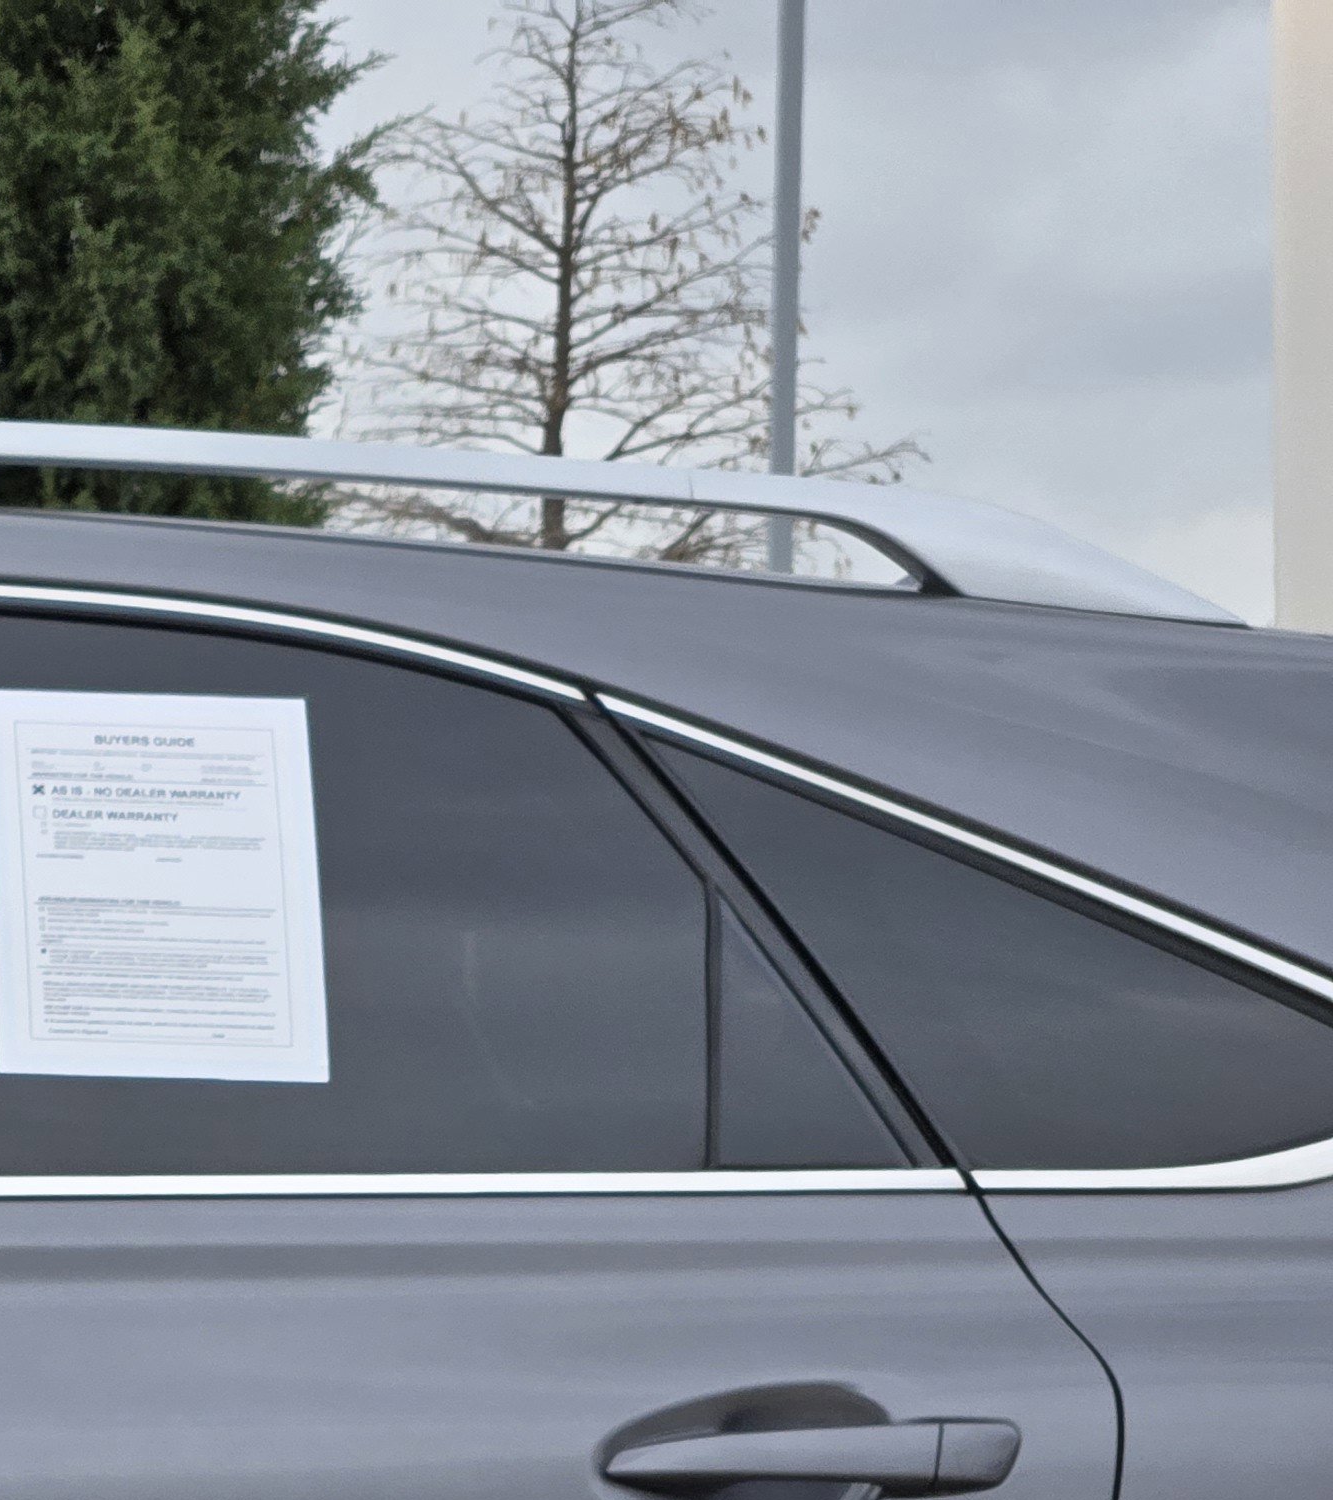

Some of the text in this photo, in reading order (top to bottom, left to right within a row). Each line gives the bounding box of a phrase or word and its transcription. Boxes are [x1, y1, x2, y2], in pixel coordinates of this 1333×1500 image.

[94, 734, 195, 748] BUYERS GUIDE
[51, 785, 68, 796] AS
[71, 785, 83, 796] IS
[94, 786, 113, 797] NO
[115, 787, 166, 799] DEALER
[170, 789, 241, 801] WARRANTY
[52, 808, 178, 822] DEALER WARRANTY
